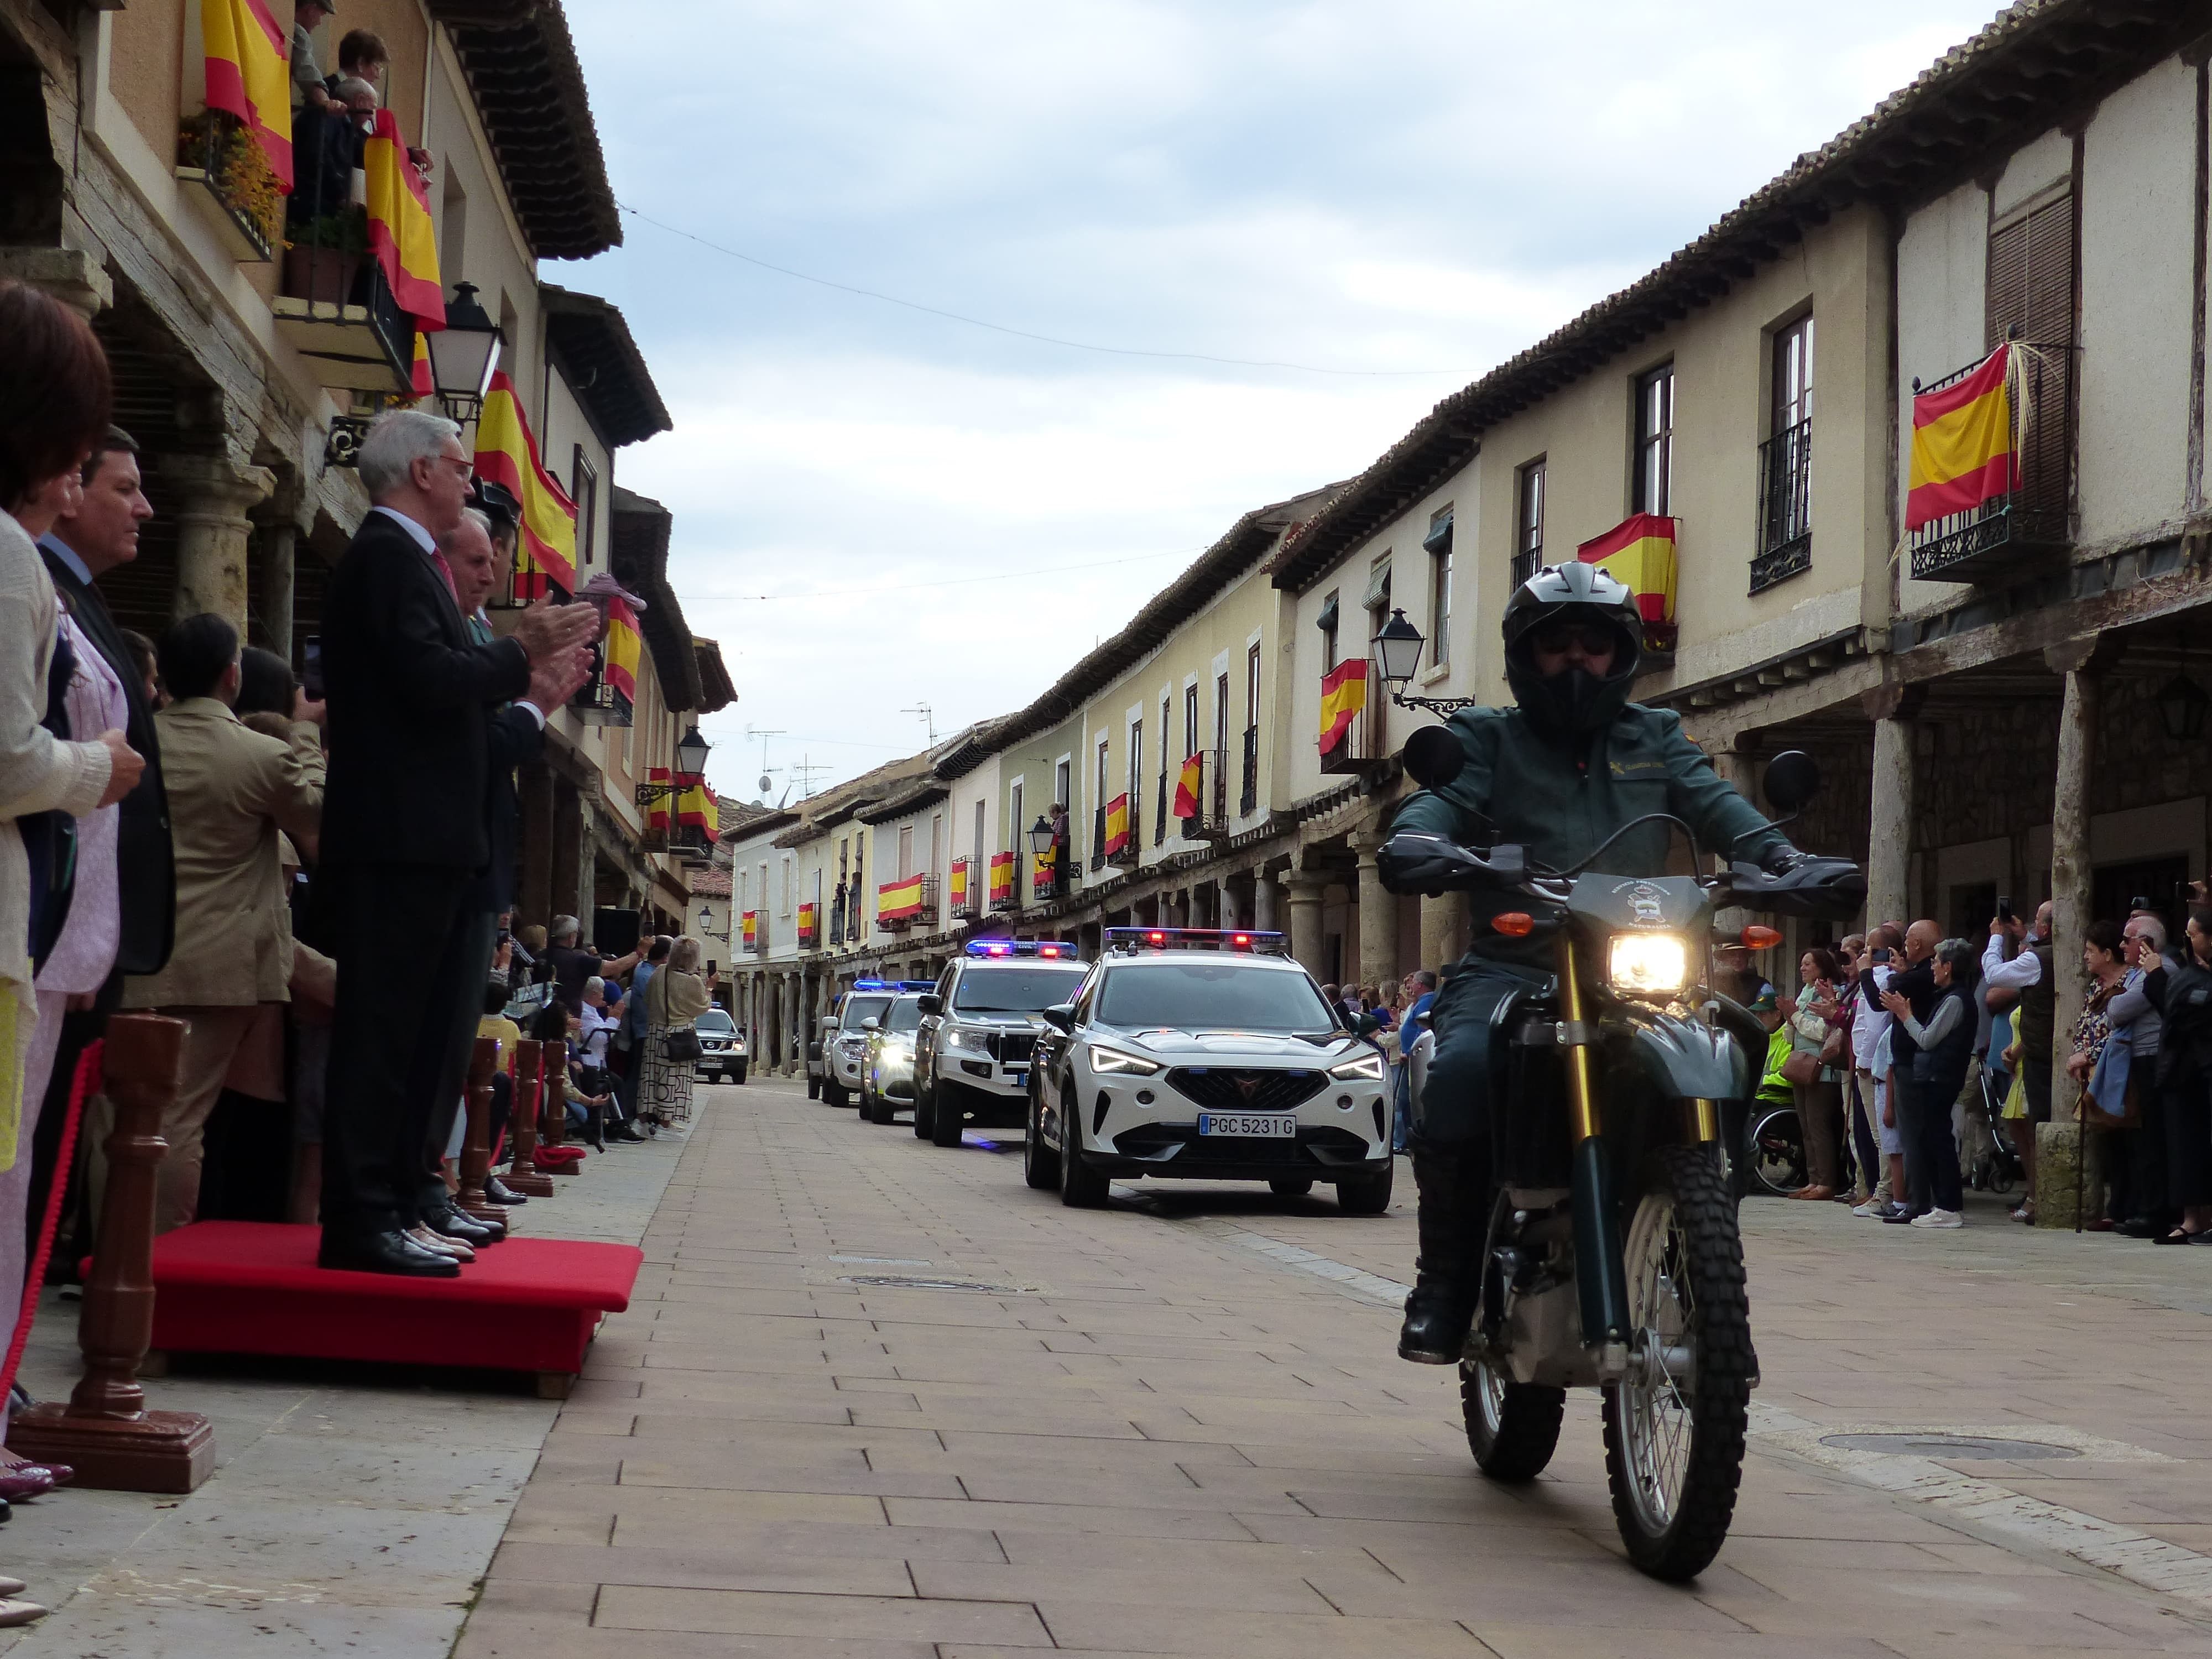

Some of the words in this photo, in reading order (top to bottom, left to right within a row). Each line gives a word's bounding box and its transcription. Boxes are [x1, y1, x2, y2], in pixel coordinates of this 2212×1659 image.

[1209, 1118, 1238, 1133] PGC
[1241, 1118, 1277, 1134] 5231
[1284, 1120, 1292, 1134] G
